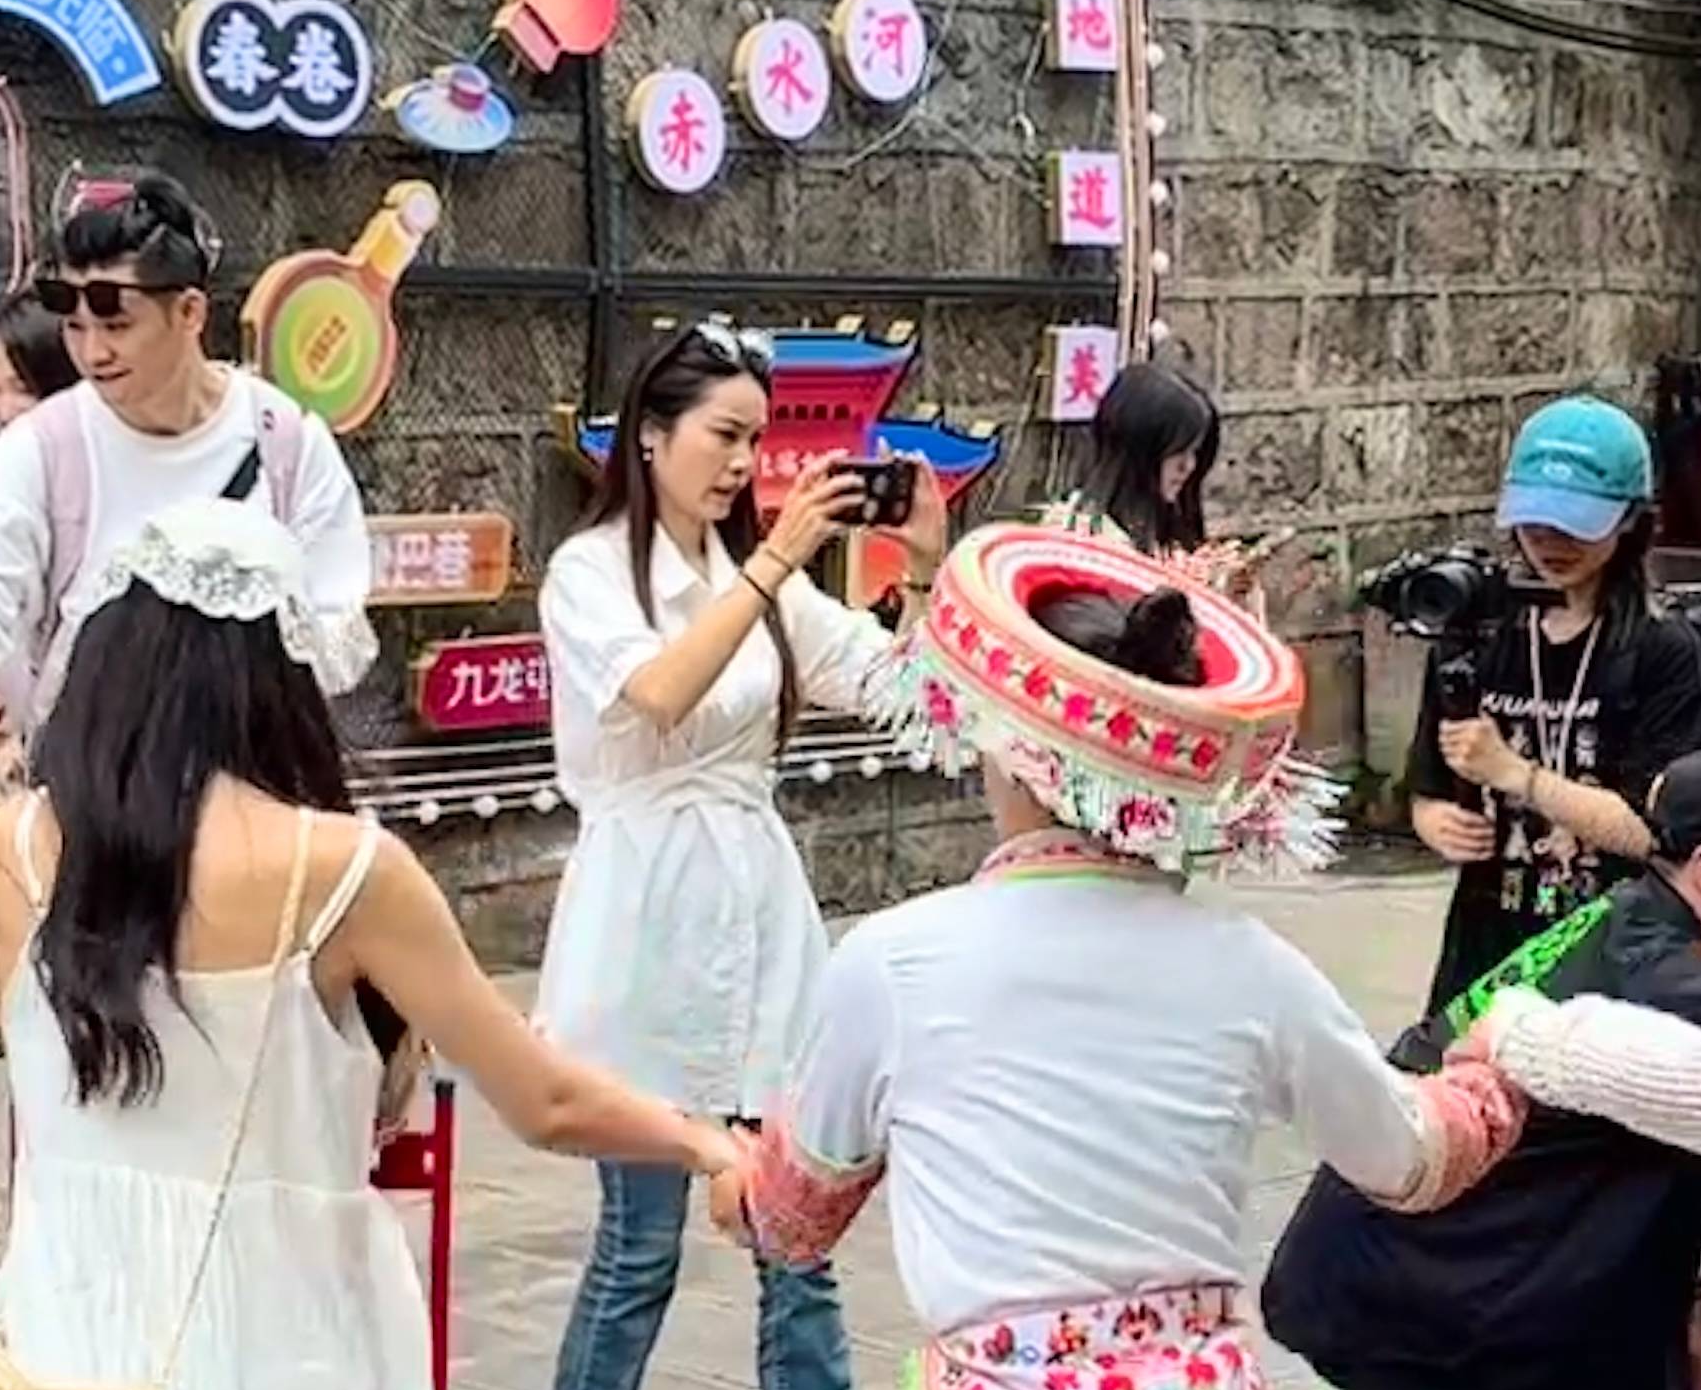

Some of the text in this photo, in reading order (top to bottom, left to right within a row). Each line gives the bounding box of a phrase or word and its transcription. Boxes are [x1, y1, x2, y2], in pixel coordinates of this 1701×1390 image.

[205, 10, 355, 104] 春卷
[660, 7, 909, 173] 赤水河
